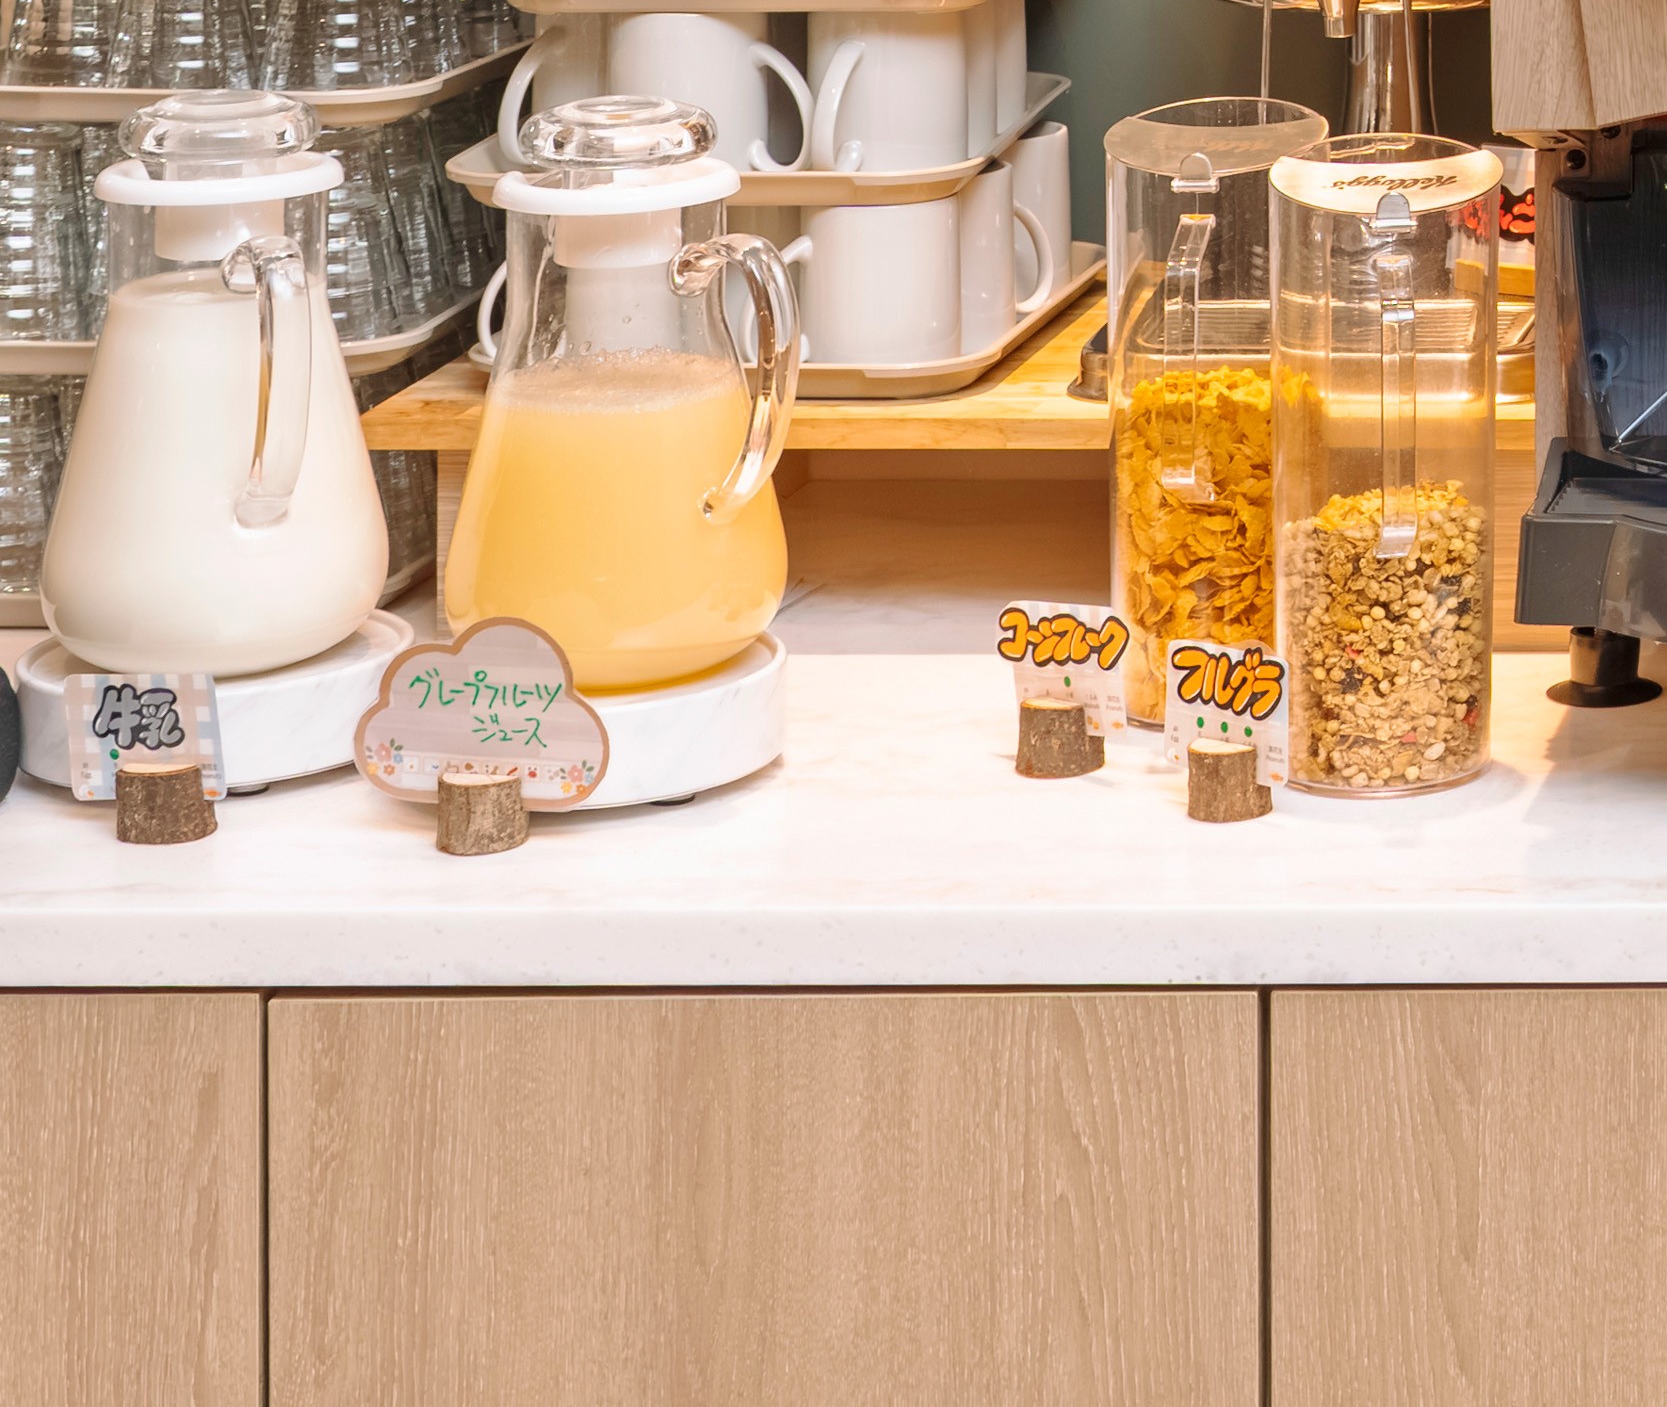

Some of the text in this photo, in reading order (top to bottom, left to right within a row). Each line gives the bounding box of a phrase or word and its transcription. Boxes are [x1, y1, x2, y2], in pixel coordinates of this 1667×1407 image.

[1332, 176, 1458, 191] Kellogg's
[997, 606, 1130, 670] コーンフレーク
[408, 669, 566, 710] グレープフルーツ
[1171, 645, 1286, 721] フルグラ
[93, 685, 186, 751] 牛乳
[471, 714, 549, 749] ジュース
